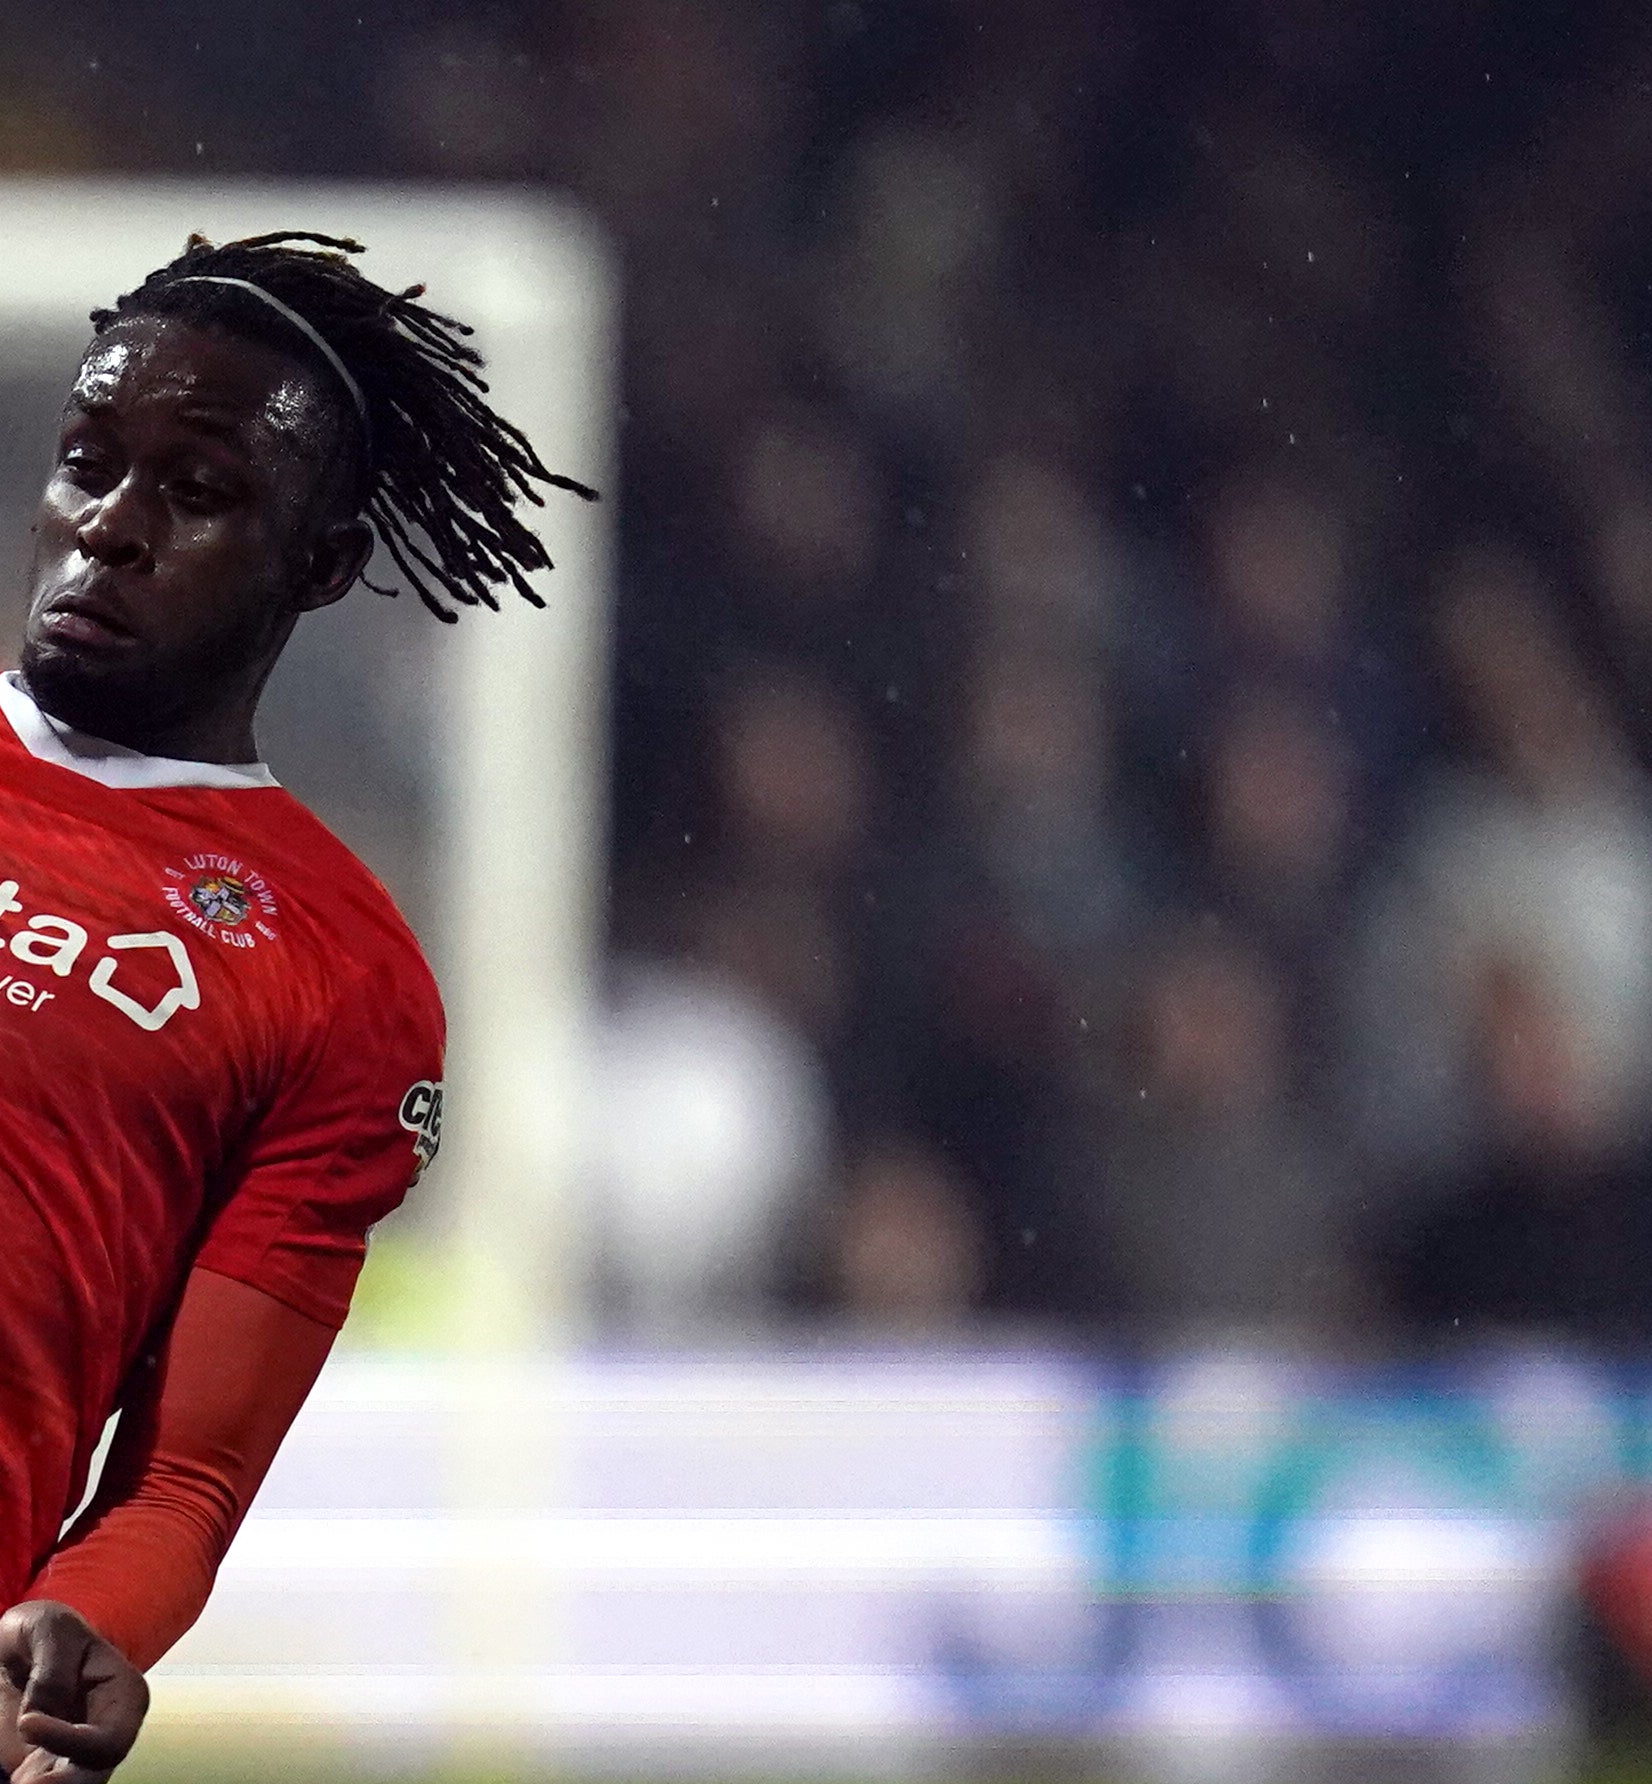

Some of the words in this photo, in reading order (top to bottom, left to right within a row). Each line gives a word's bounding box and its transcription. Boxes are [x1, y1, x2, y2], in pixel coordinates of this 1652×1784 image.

[183, 853, 244, 875] LUTON
[244, 869, 278, 916] TOWN
[162, 886, 217, 940] FOOTBALL
[220, 929, 256, 949] CLUB
